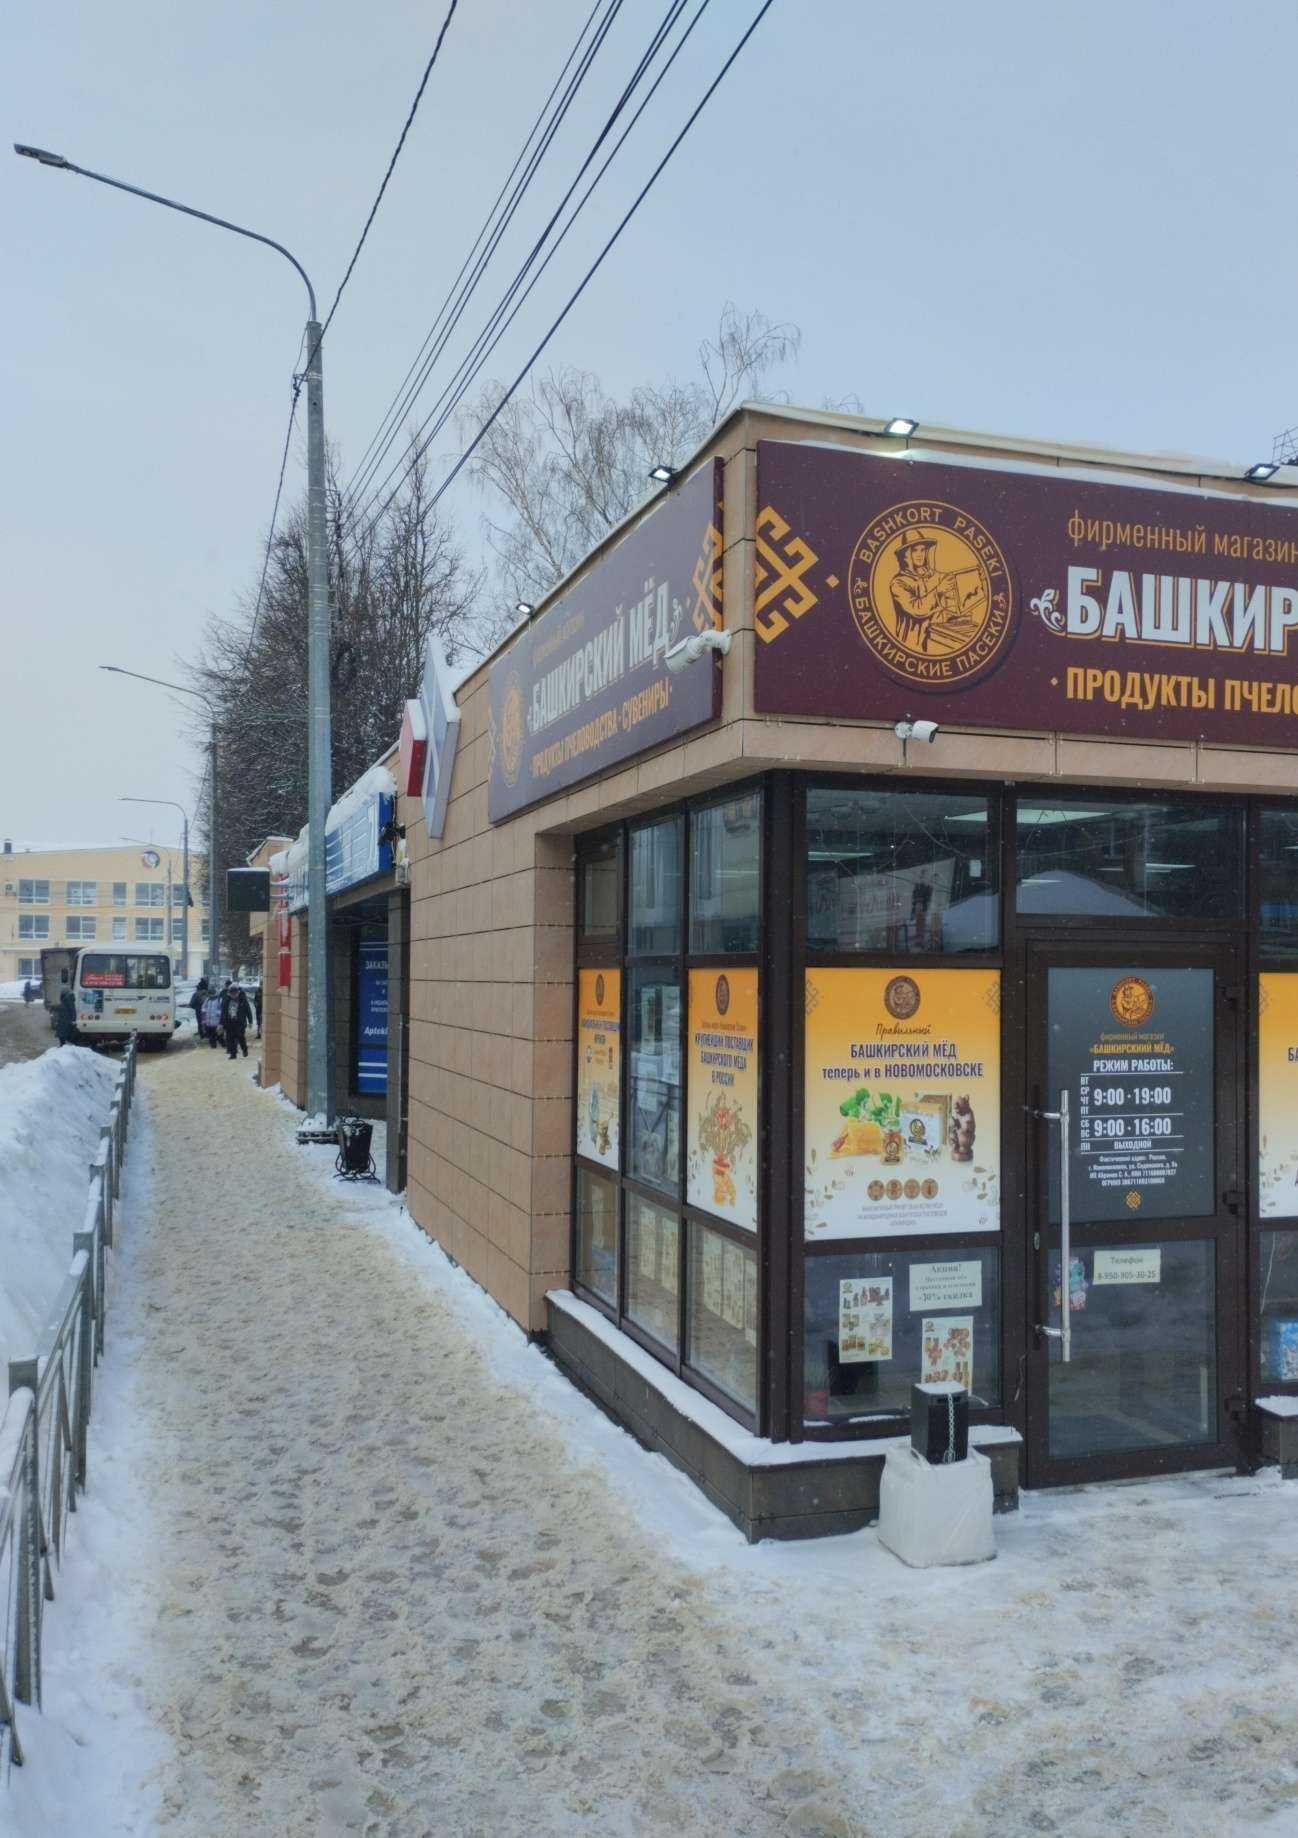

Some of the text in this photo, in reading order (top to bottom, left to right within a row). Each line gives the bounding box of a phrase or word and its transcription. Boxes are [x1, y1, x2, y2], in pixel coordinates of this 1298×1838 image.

[859, 507, 1003, 577] BASHKORT PASEKI
[1068, 509, 1206, 554] фирменный
[1067, 565, 1298, 655] БАШКИР
[855, 597, 1005, 677] БАШКИРСКИЕ ПАСЕКИ
[532, 604, 624, 735] БАШКИРСКИЙ
[1067, 667, 1215, 710] ПРОДУКТЫ
[851, 1040, 957, 1059] БАШКИРСКИЙ МЁД
[822, 1062, 983, 1081] теперь и в НОВОМОСКОВСКЕ
[1093, 1059, 1174, 1072] РЕЖИМ РАБОТЫ:
[1094, 1087, 1171, 1106] 9:00 19:00
[1094, 1118, 1171, 1136] 9:00 16:00
[1113, 1139, 1152, 1150] ВЫХОДНОЙ
